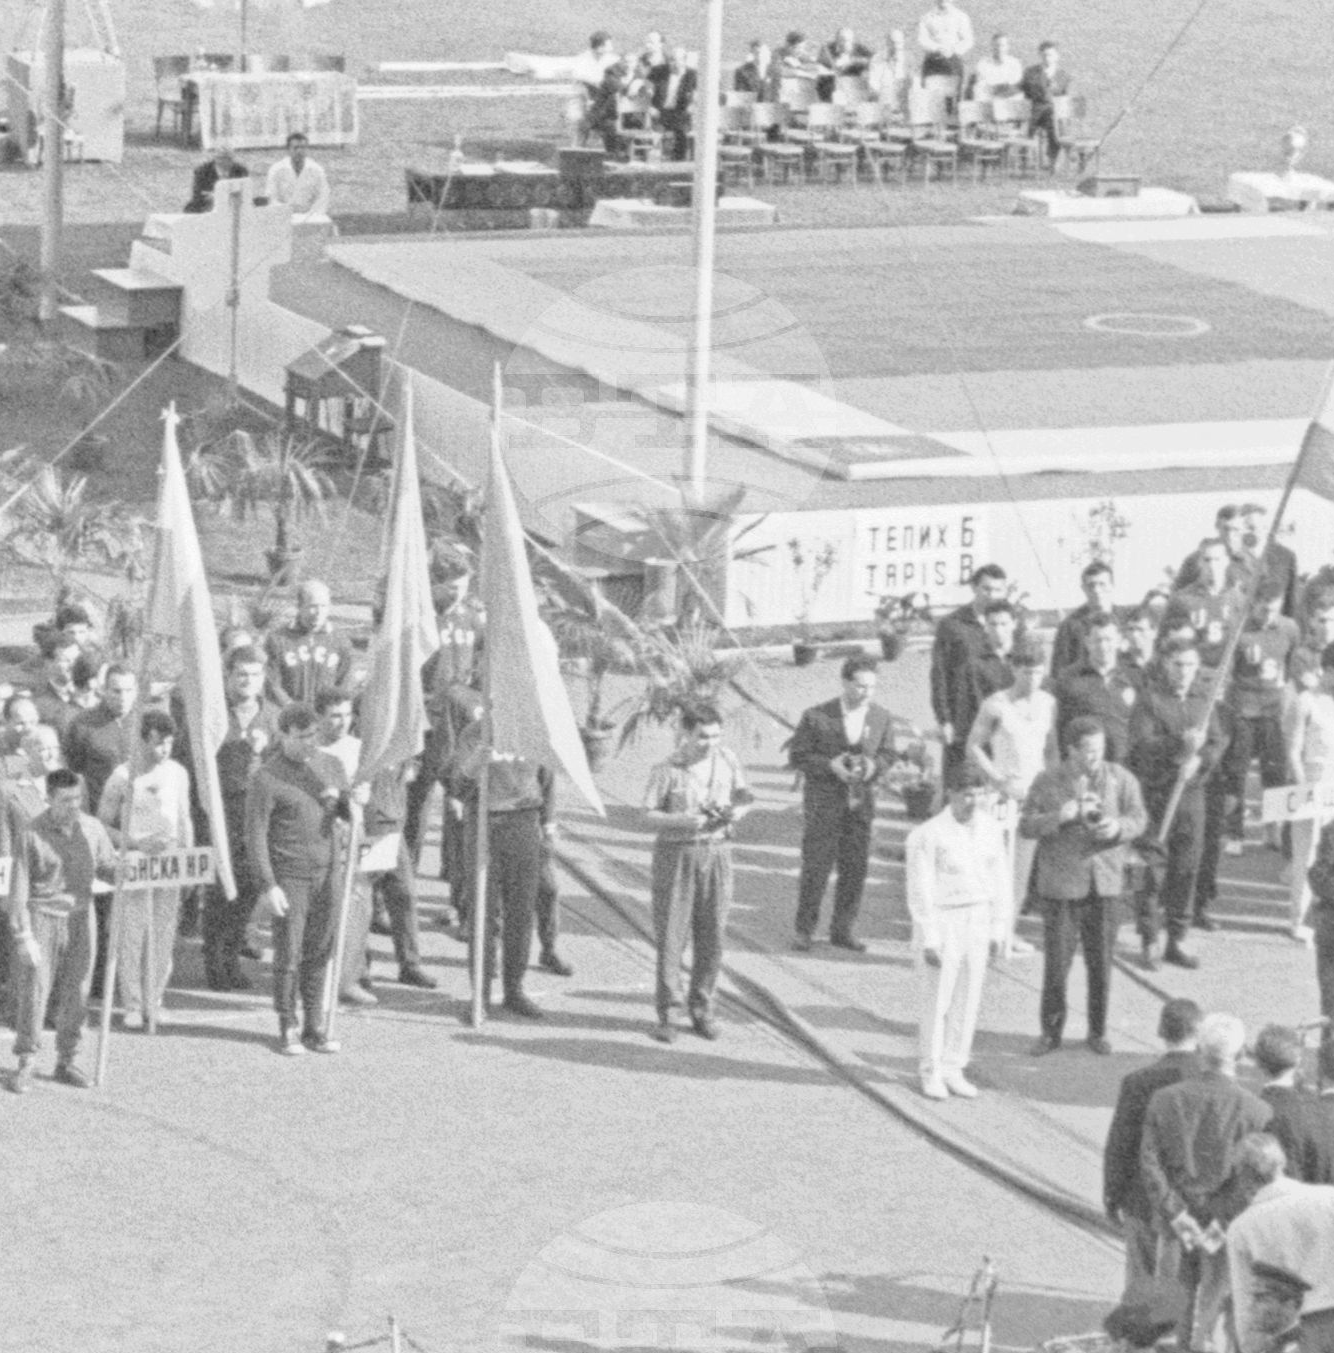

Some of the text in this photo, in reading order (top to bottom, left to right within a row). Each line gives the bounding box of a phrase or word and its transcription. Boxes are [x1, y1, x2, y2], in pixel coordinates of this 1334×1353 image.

[868, 516, 974, 552] ТЕПИХ Б
[866, 553, 973, 588] TAPIS B
